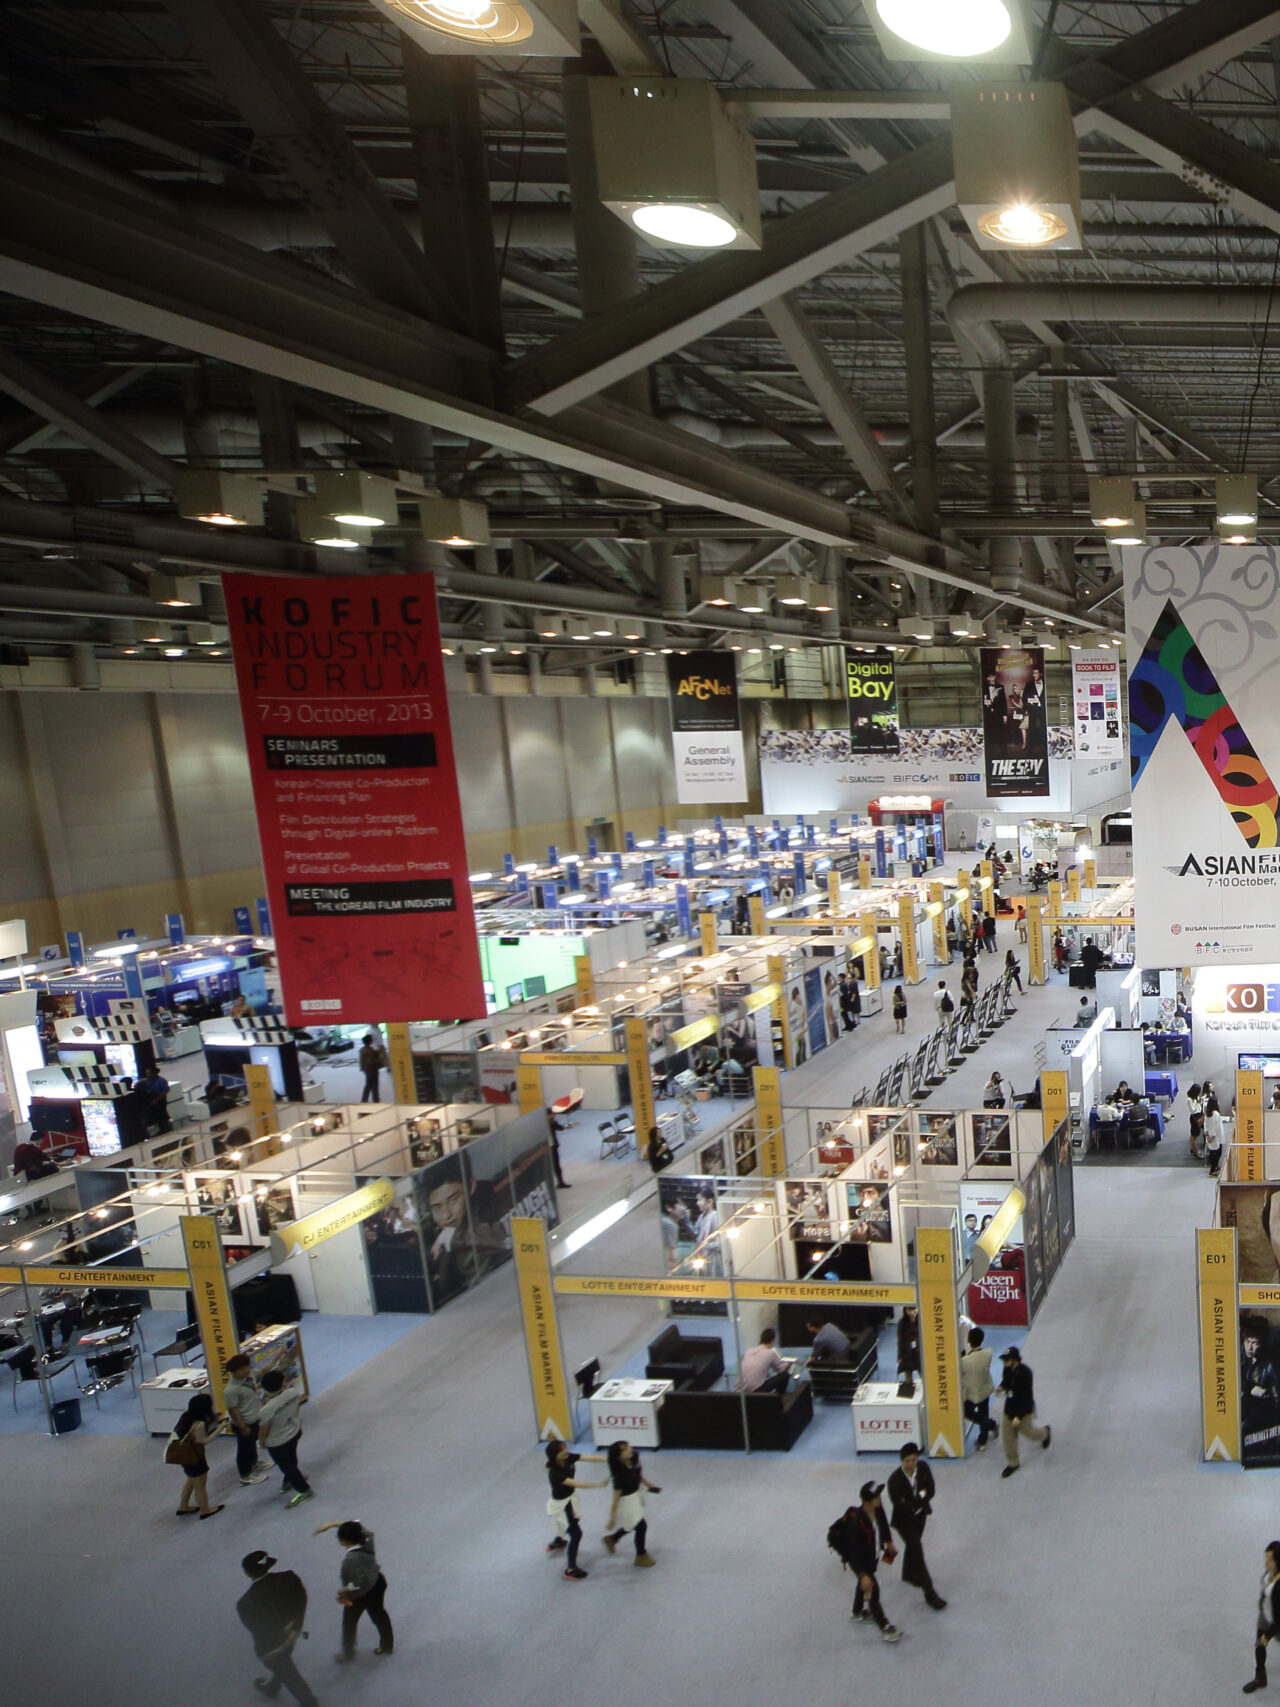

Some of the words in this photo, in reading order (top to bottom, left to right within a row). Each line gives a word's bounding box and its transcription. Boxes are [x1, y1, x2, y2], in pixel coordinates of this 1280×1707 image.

[241, 596, 422, 627] KOFIC
[245, 630, 422, 660] INDUSTRY
[848, 662, 892, 676] Digital
[252, 661, 430, 692] FORUM
[848, 677, 894, 701] Bay
[258, 704, 291, 722] 7-9
[297, 704, 382, 723] October,
[387, 703, 433, 720] 2013
[267, 739, 339, 751] SEMINARS
[688, 745, 730, 755] General
[285, 754, 387, 766] PRESENTATION
[684, 756, 736, 767] Assembly
[991, 759, 1017, 775] THE
[275, 778, 354, 788] Korean-Chinese
[356, 777, 430, 787] Co-Production
[349, 792, 372, 801] Plan
[303, 814, 362, 824] Distribution
[282, 828, 321, 840] through
[285, 851, 350, 860] Presentation
[287, 864, 297, 874] of
[1179, 852, 1255, 876] ASIAN
[1232, 876, 1277, 887] October,
[290, 888, 350, 899] MEETING
[315, 902, 334, 911] THE
[335, 902, 376, 911] KOREAN
[378, 900, 402, 910] FILM
[404, 898, 452, 908] INDUSTRY
[1206, 1019, 1247, 1031] Korean
[1248, 1019, 1271, 1030] Film
[302, 1230, 316, 1245] CJ
[316, 1194, 390, 1240] ENTERTAINMENT
[192, 1239, 211, 1249] C01
[924, 1254, 945, 1263] D01
[1206, 1254, 1226, 1263] E01
[58, 1272, 72, 1281] CJ
[74, 1272, 155, 1283] ENTERTAINMENT
[582, 1281, 615, 1290] LOTTE
[618, 1281, 705, 1292] ENTERTAINMENT
[762, 1286, 797, 1296] LOTTE
[800, 1287, 889, 1298] ENTERTAINMENT
[204, 1281, 218, 1315] ASIAN
[980, 1287, 1020, 1302] Night
[531, 1285, 545, 1320] ASIAN
[933, 1297, 943, 1331] ASIAN
[1214, 1298, 1224, 1334] ASIAN
[209, 1317, 222, 1344] FILM
[537, 1323, 549, 1348] FILM
[935, 1334, 945, 1362] FILM
[1215, 1337, 1224, 1364] FILM
[541, 1351, 555, 1396] MARKET
[937, 1365, 948, 1412] MARKET
[1215, 1367, 1226, 1414] MARKET
[598, 1415, 648, 1426] LOTTE
[861, 1420, 912, 1429] LOTTE
